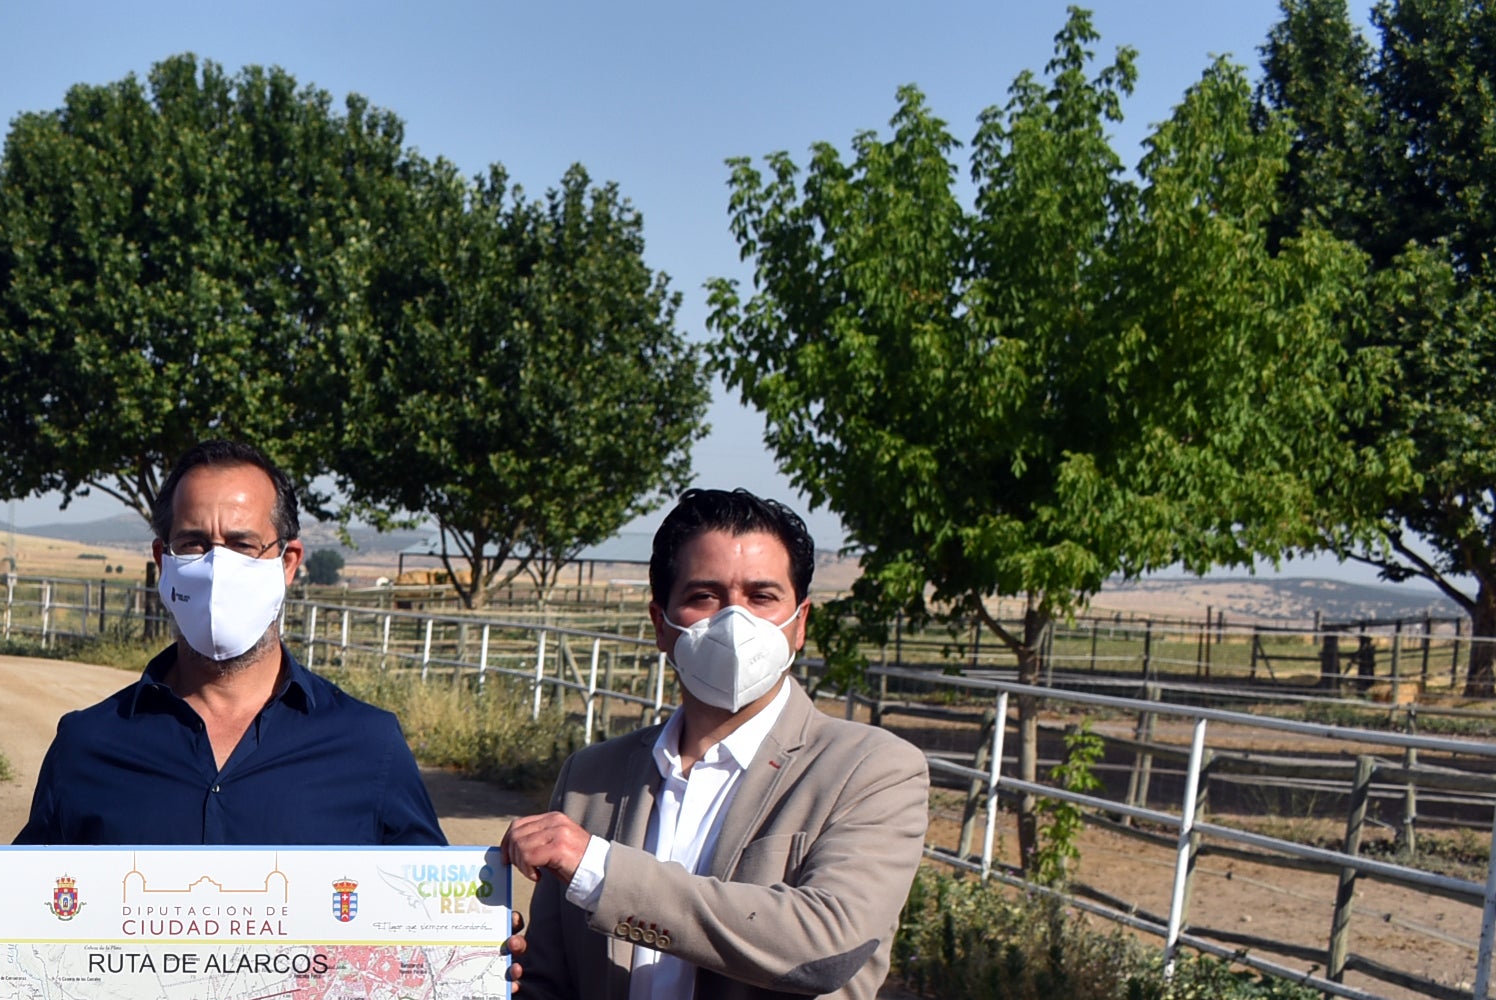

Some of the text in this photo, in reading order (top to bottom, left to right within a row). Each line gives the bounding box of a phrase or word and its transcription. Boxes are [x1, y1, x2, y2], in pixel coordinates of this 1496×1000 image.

[417, 880, 494, 898] CIUDAD
[122, 904, 288, 916] DIPUTACIÓN DE
[440, 897, 493, 914] REAL
[122, 920, 288, 935] CIUDAD REAL
[88, 953, 328, 974] RUTA DE ALARCOS
